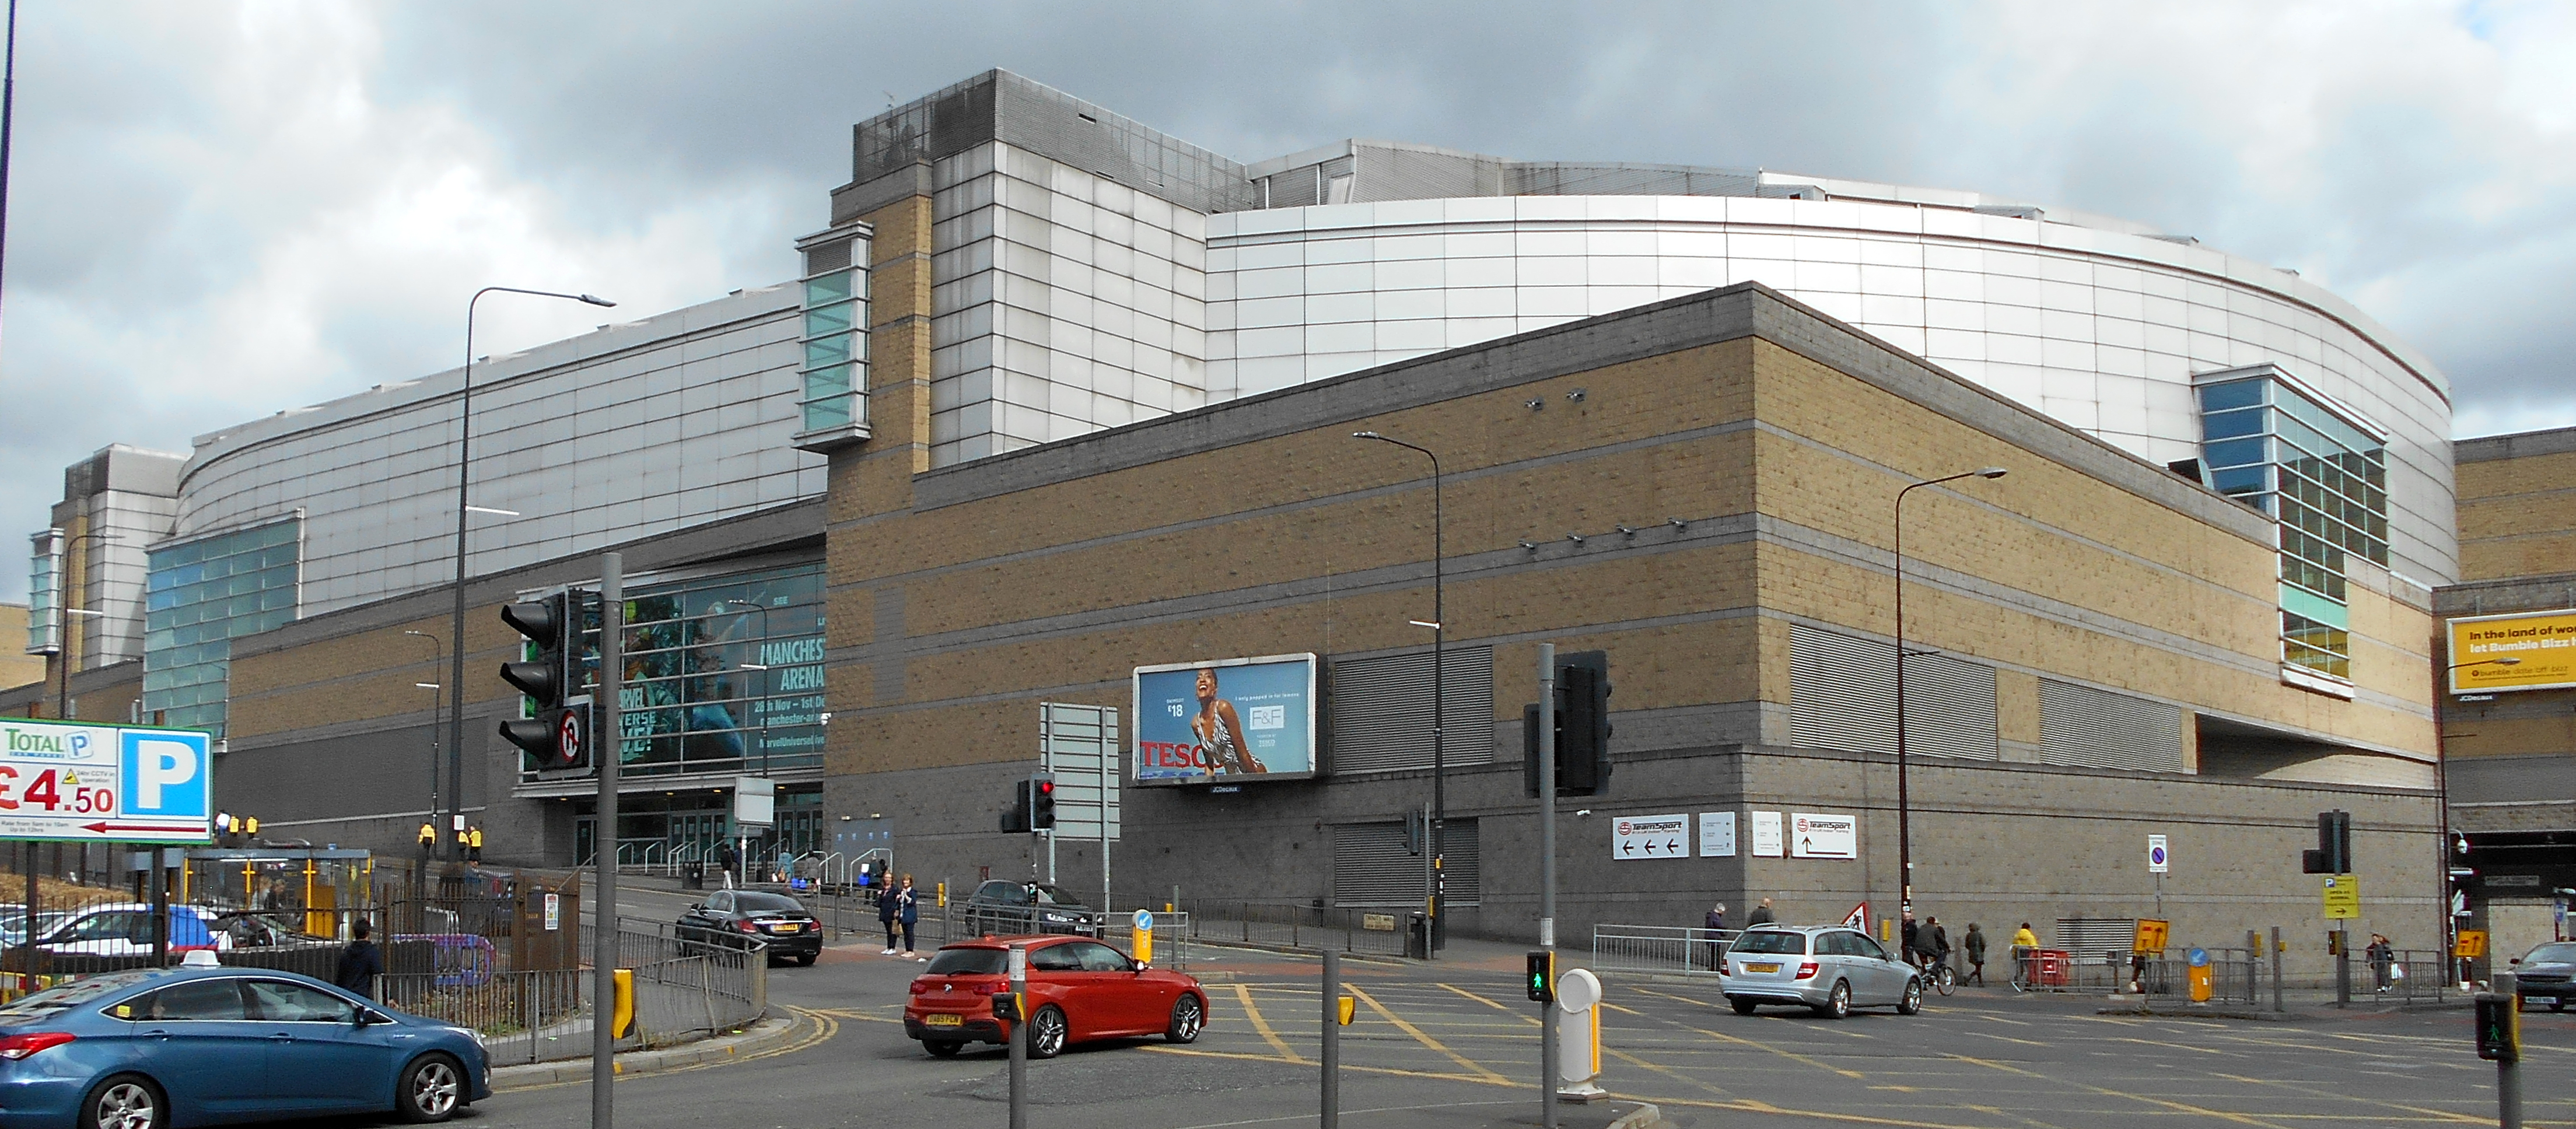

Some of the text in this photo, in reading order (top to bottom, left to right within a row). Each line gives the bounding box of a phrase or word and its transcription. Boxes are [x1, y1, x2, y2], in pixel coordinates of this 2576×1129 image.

[773, 595, 789, 605] SEE
[2470, 632, 2482, 640] In
[2484, 630, 2505, 639] the
[2508, 627, 2536, 637] land
[2539, 626, 2553, 635] of
[760, 637, 826, 665] MANCHES
[2470, 644, 2487, 653] let
[2489, 640, 2539, 652] Bumble
[2540, 638, 2569, 648] Bizz
[780, 665, 825, 690] ARENA
[775, 699, 791, 711] Nov
[802, 697, 813, 709] 1st
[1168, 704, 1183, 717] £18
[1252, 709, 1281, 727] F&F
[71, 735, 88, 756] P
[138, 739, 197, 809] P
[1632, 821, 1682, 831] TeamSport
[1809, 821, 1851, 830] TeamSport
